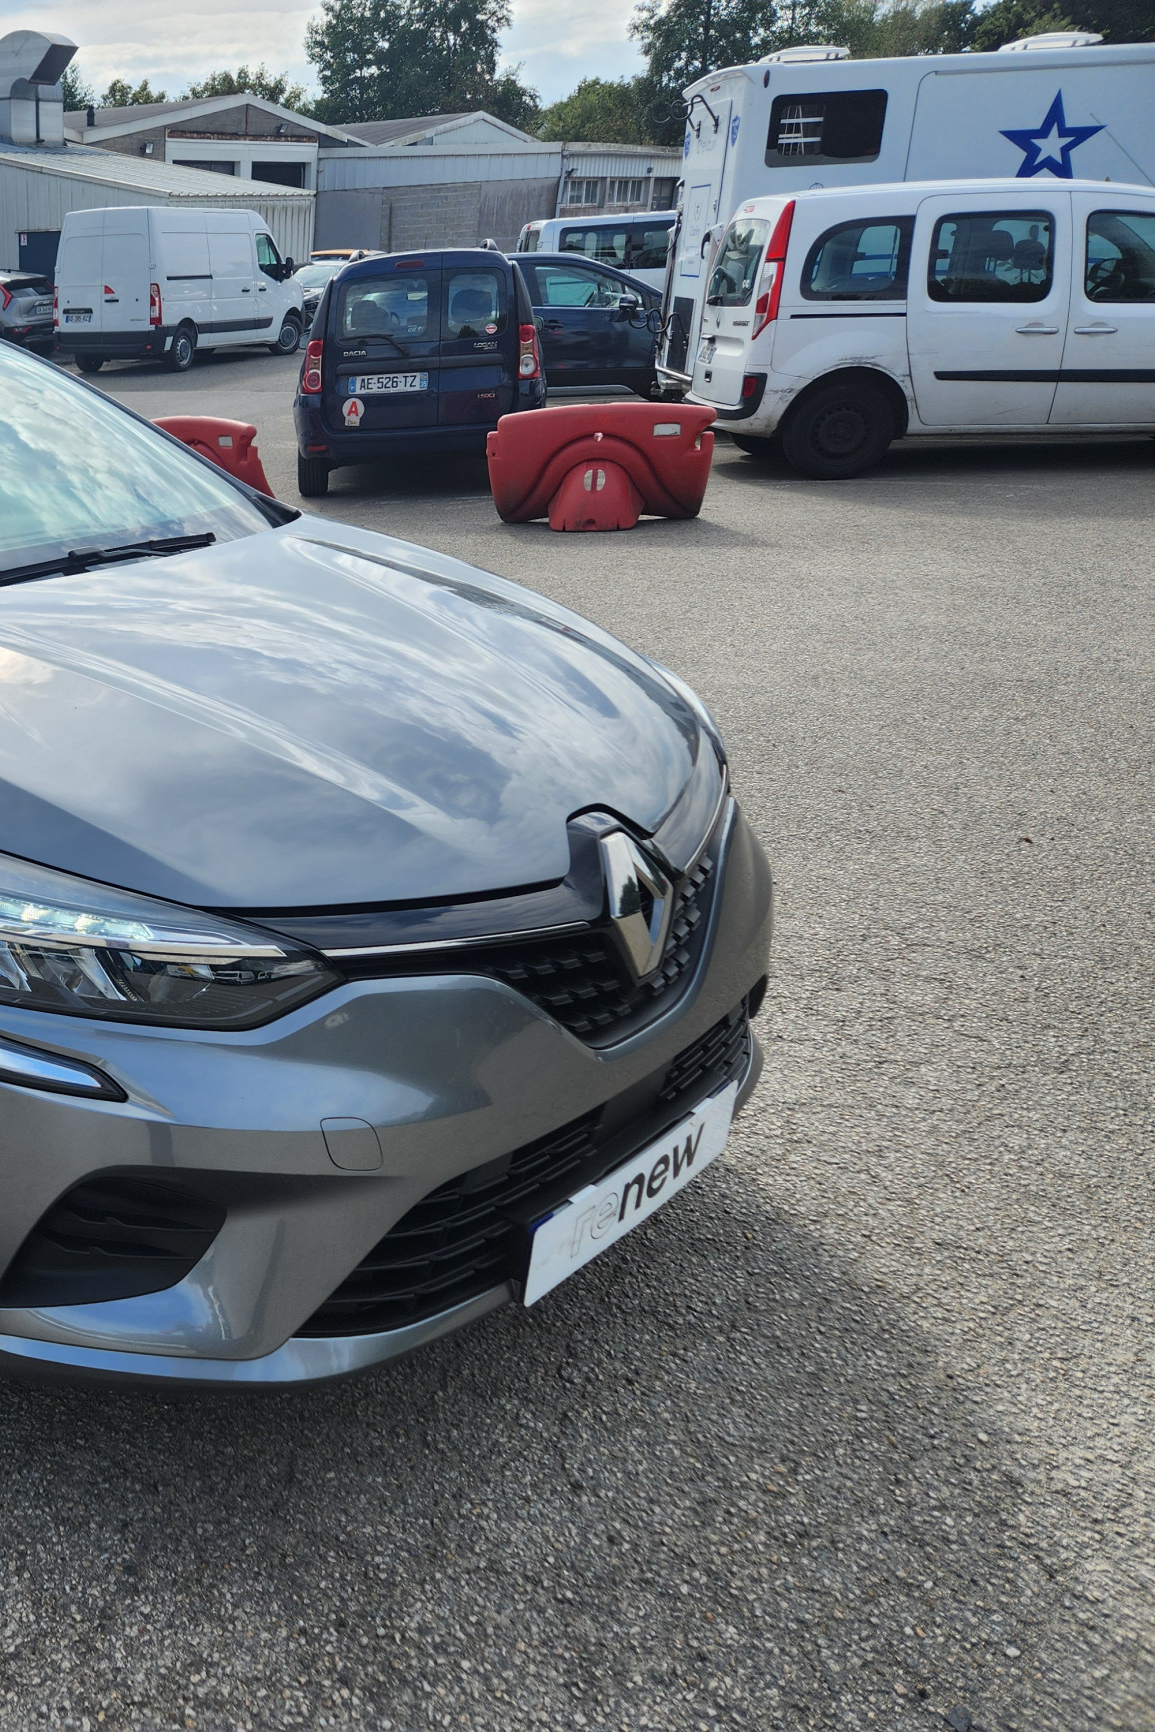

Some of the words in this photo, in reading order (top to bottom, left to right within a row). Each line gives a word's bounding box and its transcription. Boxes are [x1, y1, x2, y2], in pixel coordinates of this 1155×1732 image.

[359, 375, 417, 391] AE-526-TZ
[347, 401, 359, 417] A
[570, 1122, 706, 1259] renew
